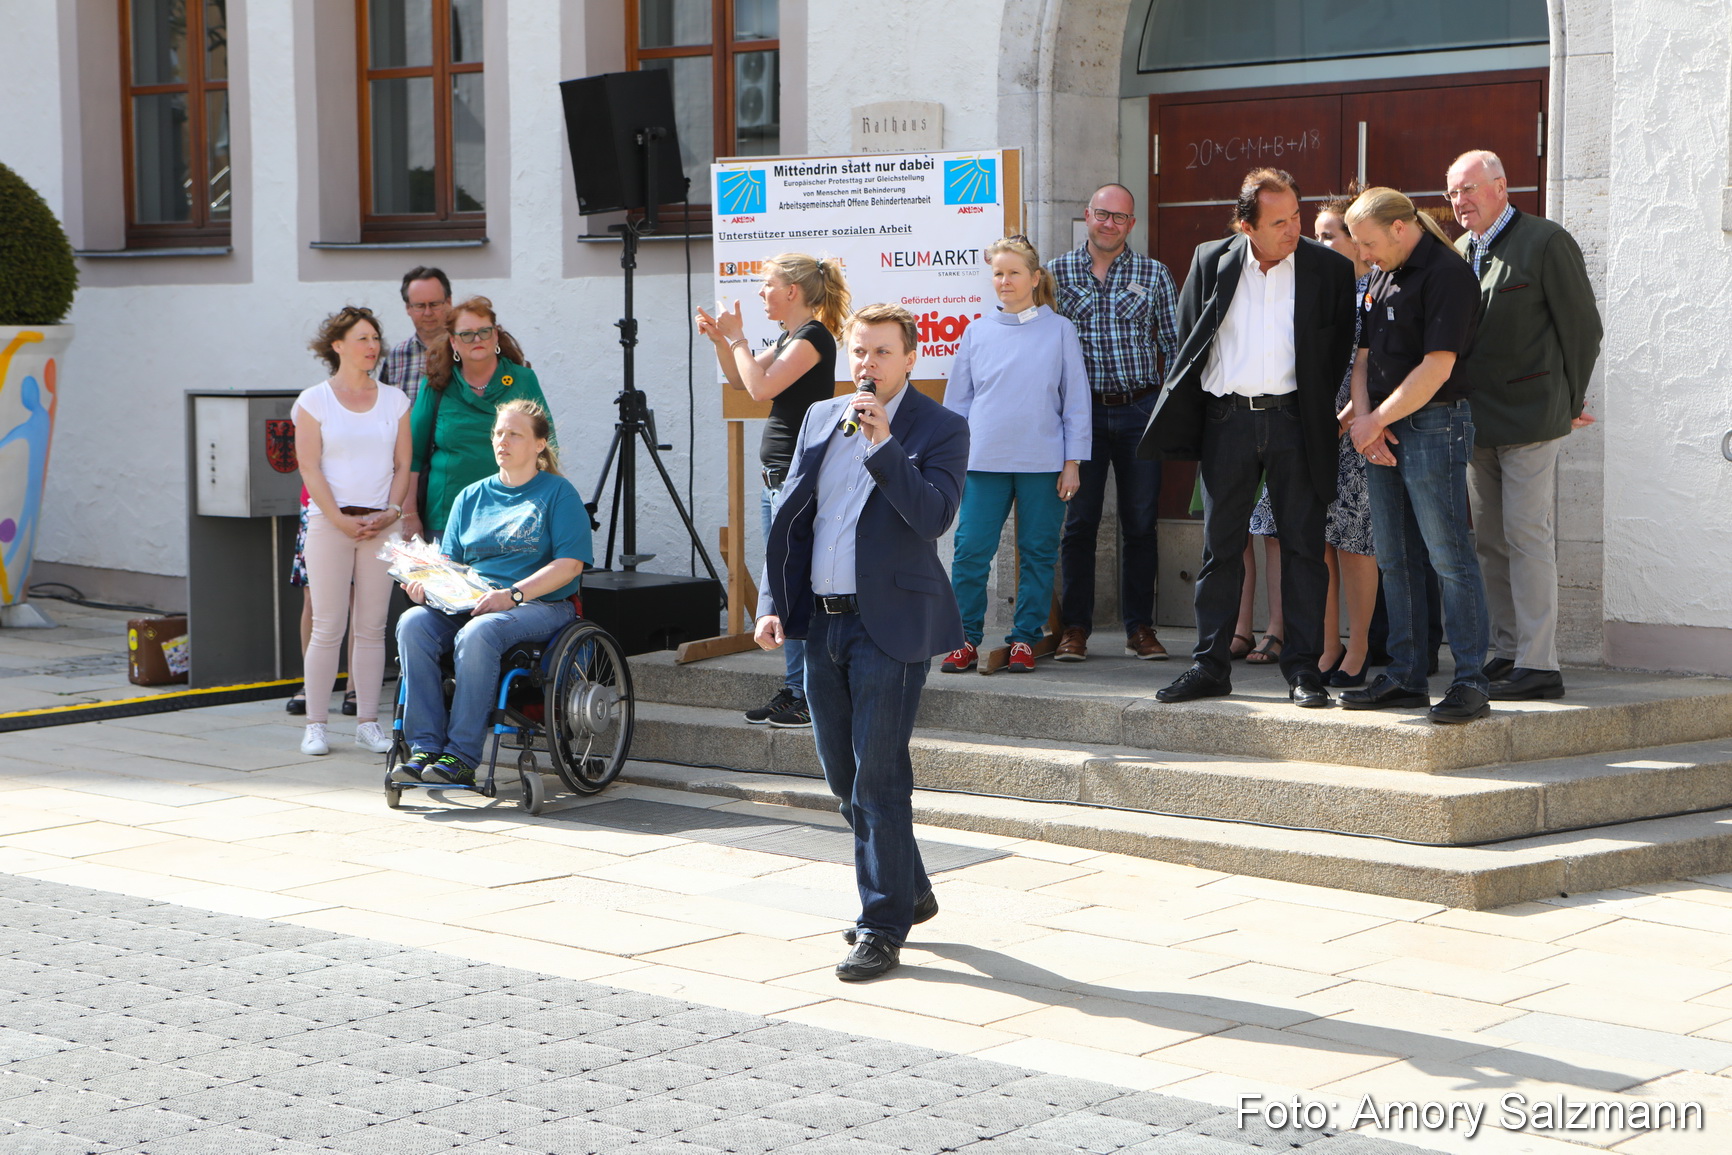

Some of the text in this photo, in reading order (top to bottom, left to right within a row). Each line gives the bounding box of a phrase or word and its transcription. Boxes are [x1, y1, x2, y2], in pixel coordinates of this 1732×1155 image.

[862, 116, 927, 133] Rathaus
[774, 158, 934, 177] Mittendrin statt nur dabei
[783, 179, 827, 187] Europäischer
[828, 176, 863, 185] Protesttag
[876, 174, 925, 182] Gleichstellung
[816, 188, 849, 196] Menschen
[863, 186, 906, 194] Behinderung
[779, 195, 931, 211] Arbeitsgemeinschaft Offene Behindertenarbeit
[718, 224, 912, 241] Unterstützer unserer sozialen Arbeit
[881, 249, 979, 267] NEUMARKT
[901, 294, 981, 305] Gefördert durch die
